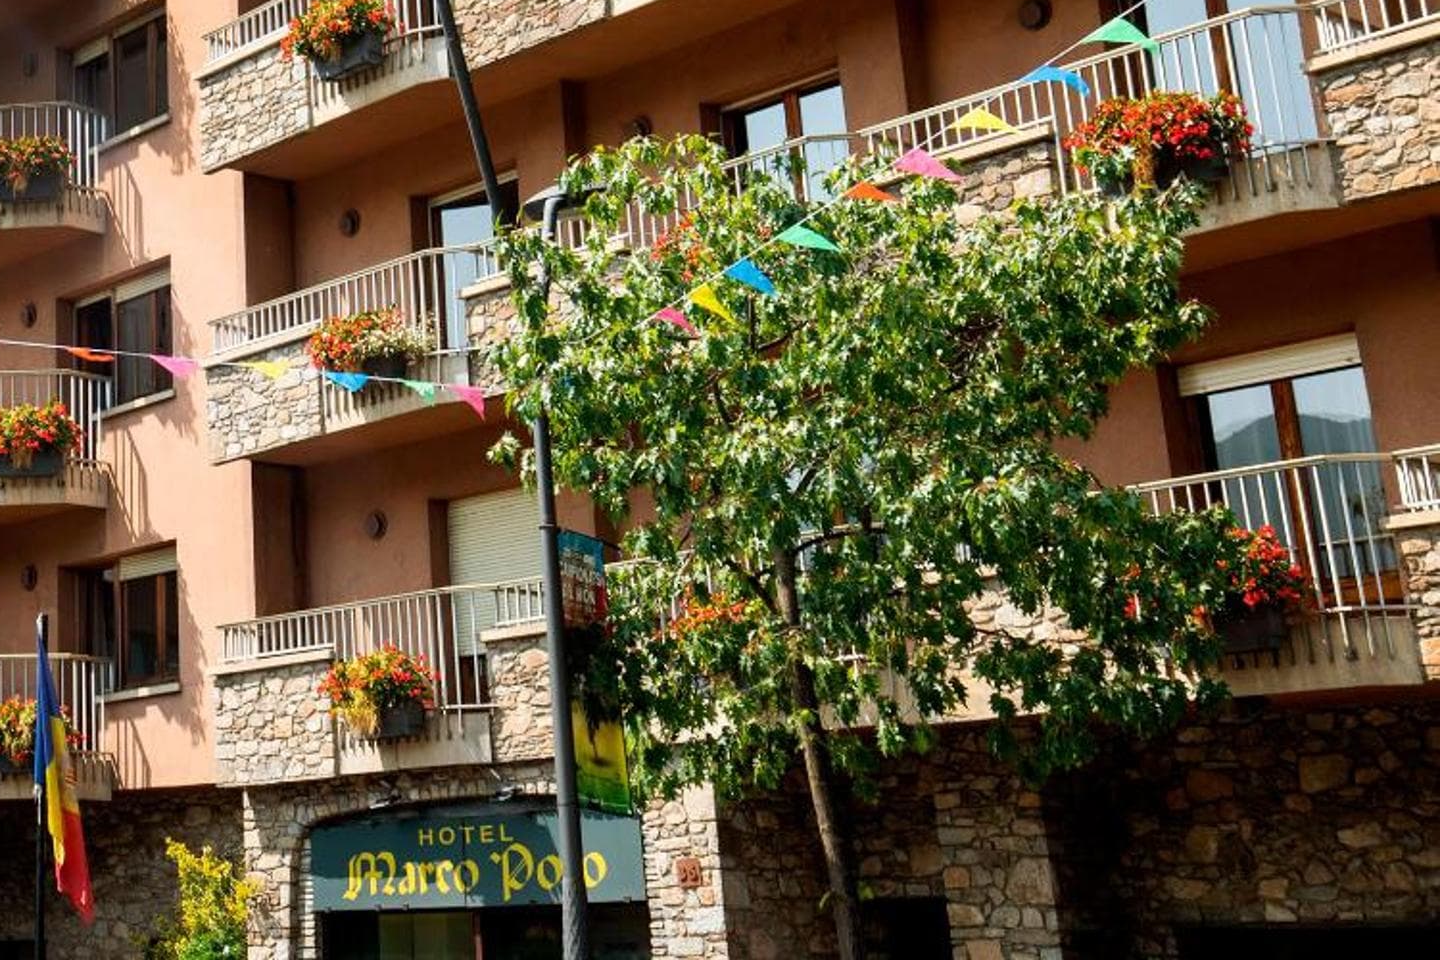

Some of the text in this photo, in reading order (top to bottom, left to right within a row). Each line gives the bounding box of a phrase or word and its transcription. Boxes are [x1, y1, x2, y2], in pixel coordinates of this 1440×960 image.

[417, 823, 515, 846] HOTEL
[342, 842, 608, 903] Marco Poo
